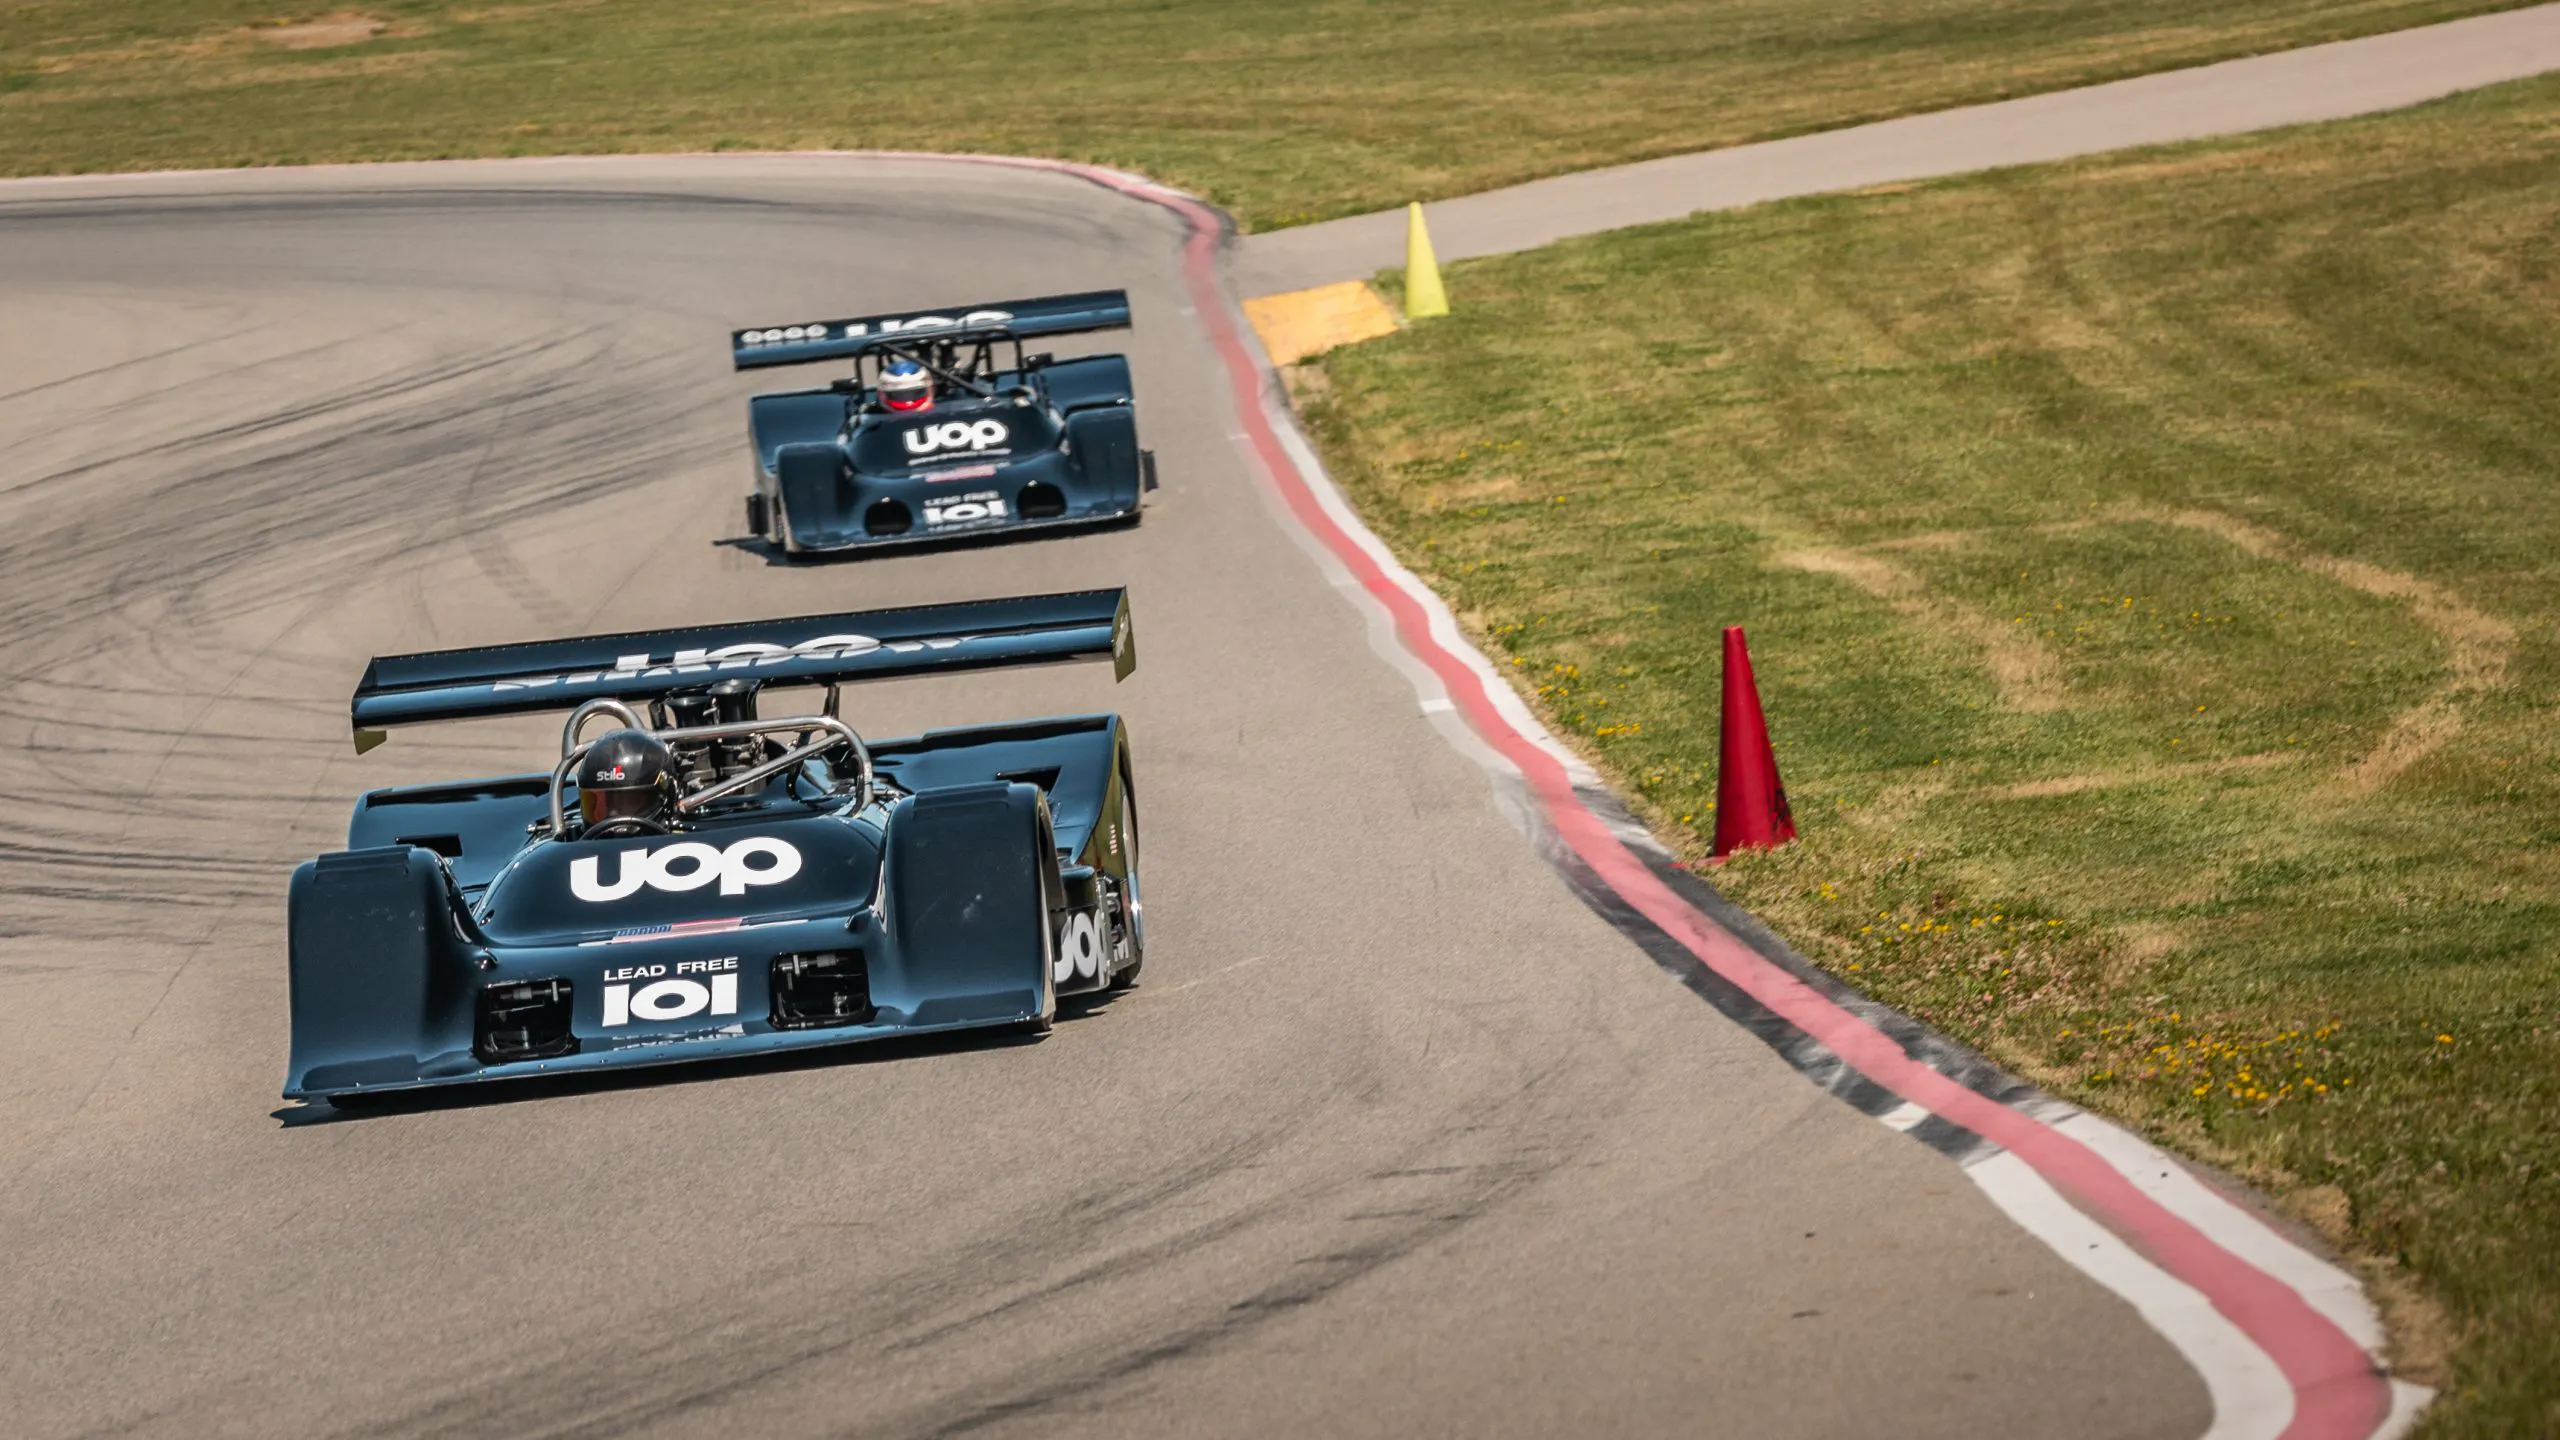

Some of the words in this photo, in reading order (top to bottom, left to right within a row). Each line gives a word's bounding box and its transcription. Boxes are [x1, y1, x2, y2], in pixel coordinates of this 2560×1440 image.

[596, 765, 626, 782] Stilo
[604, 964, 667, 982] LEAD
[676, 956, 739, 976] FREE
[602, 973, 738, 1027] 101
